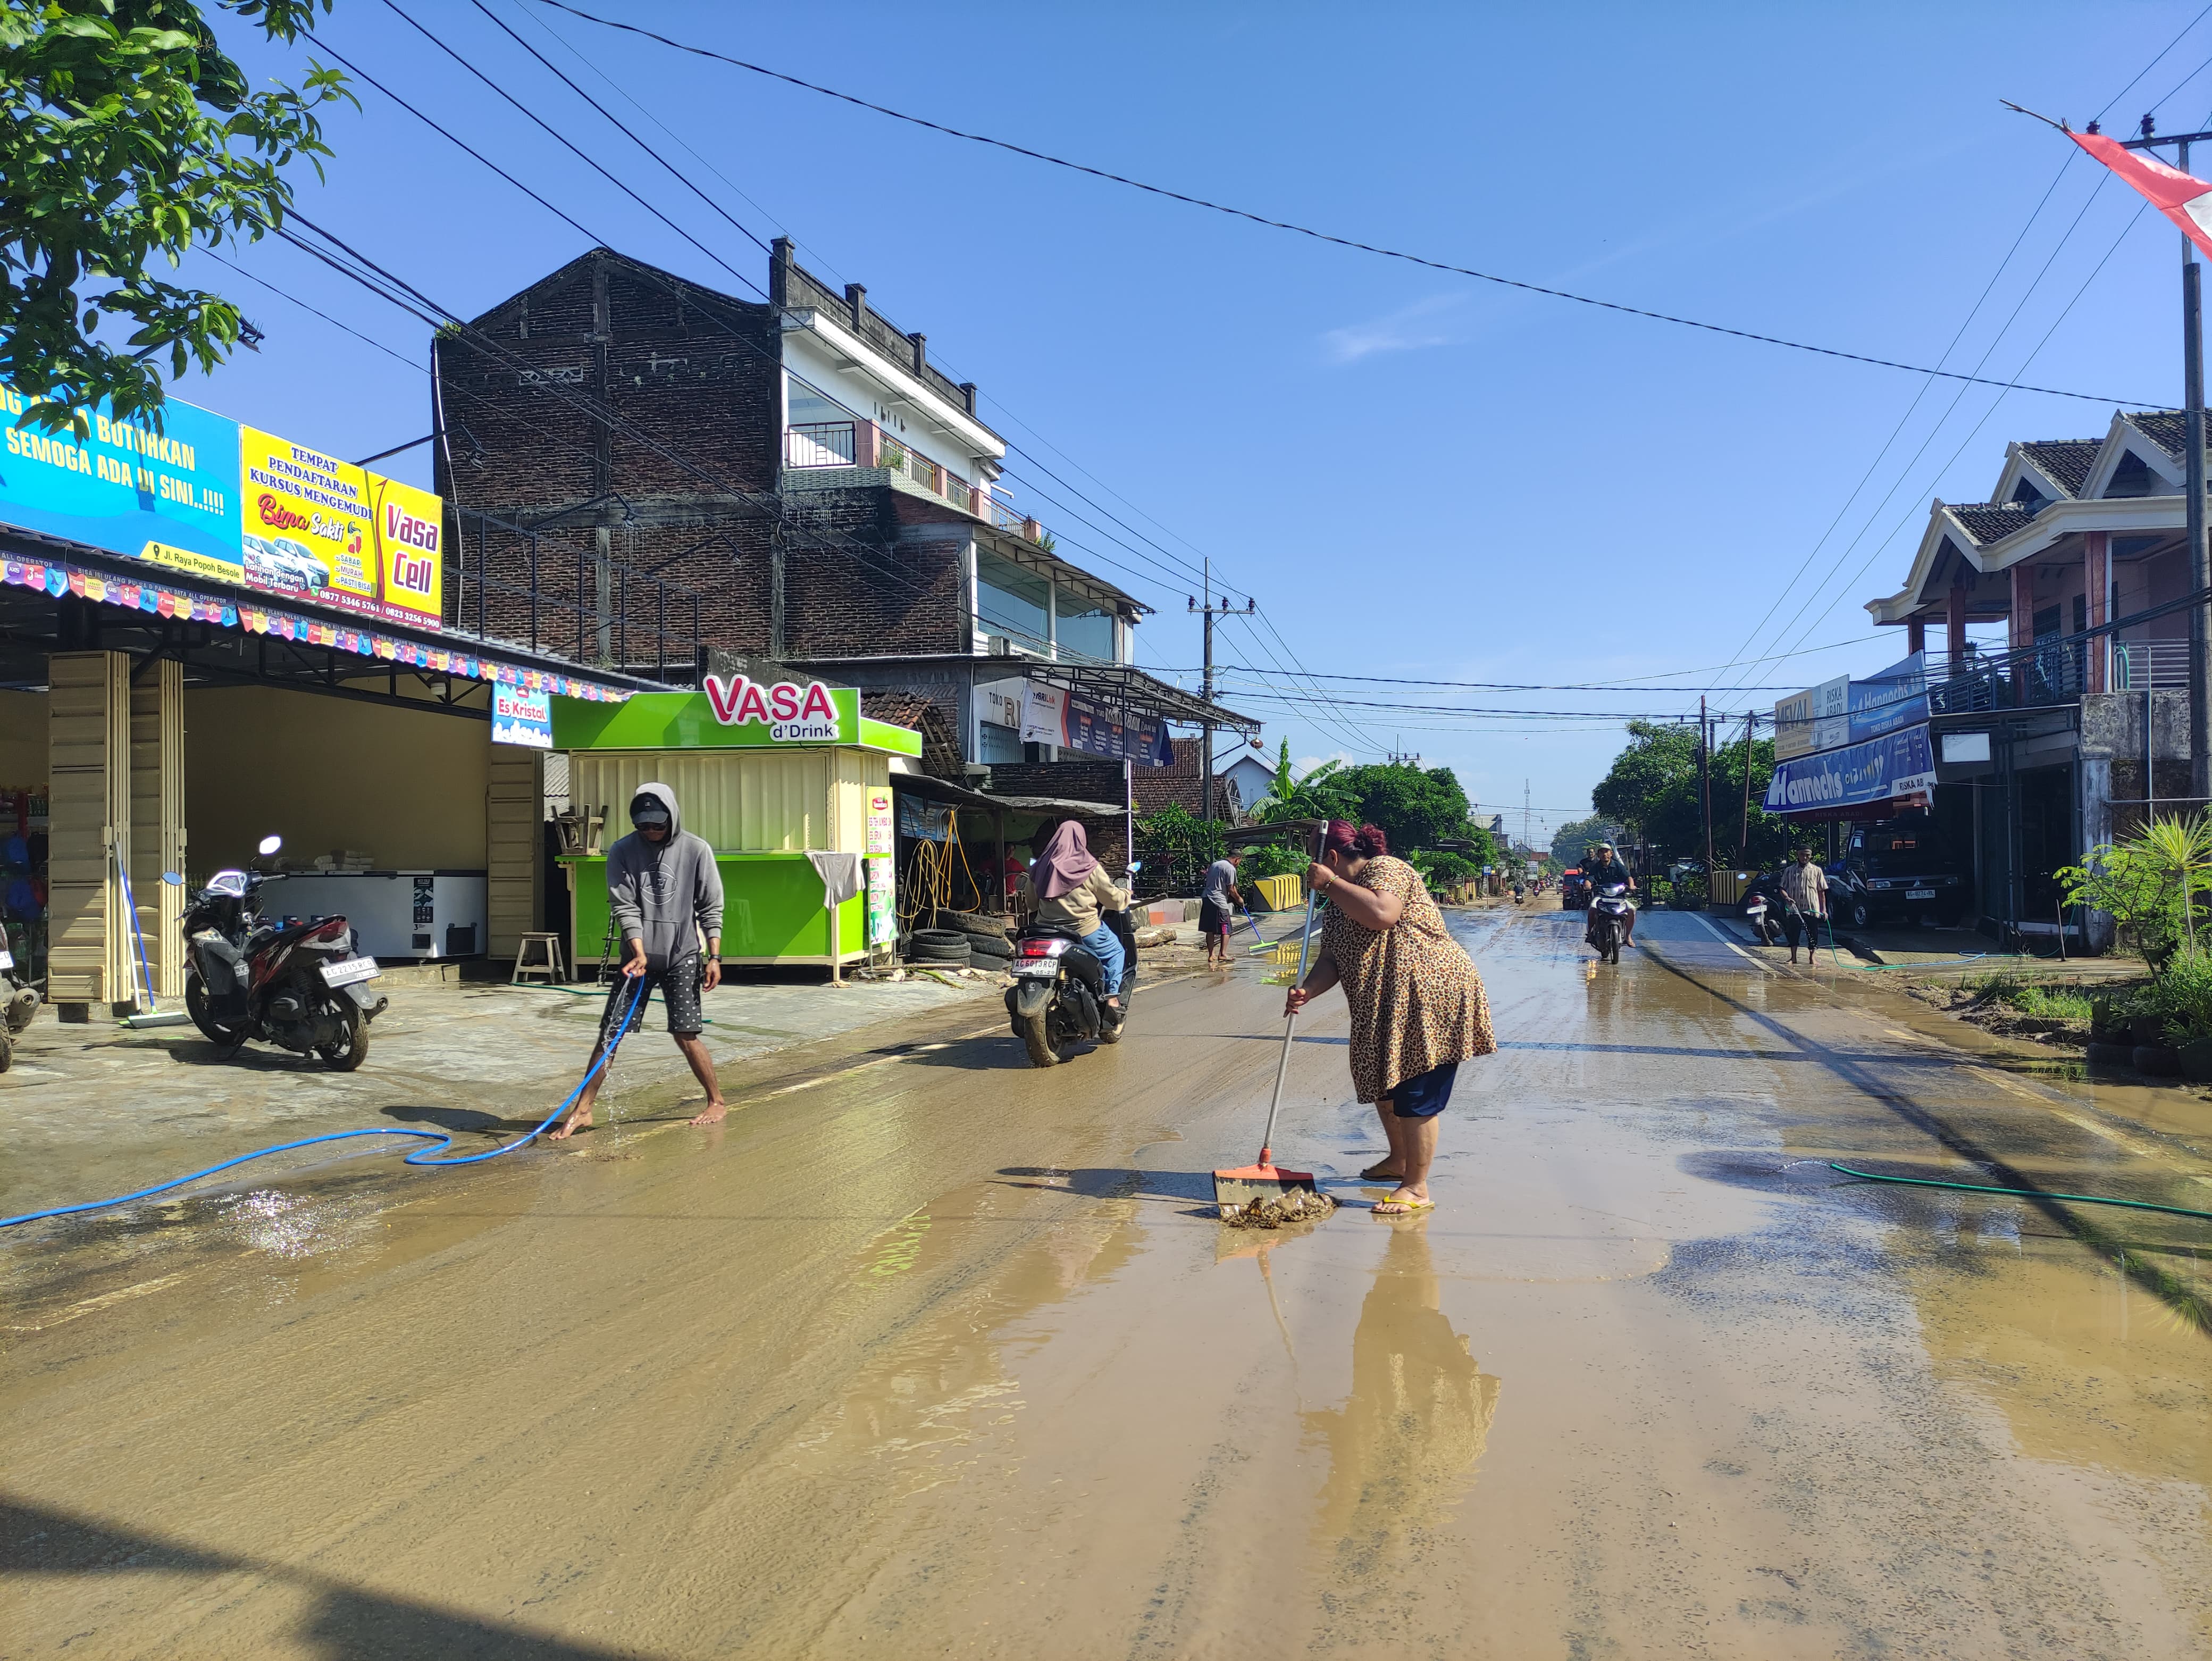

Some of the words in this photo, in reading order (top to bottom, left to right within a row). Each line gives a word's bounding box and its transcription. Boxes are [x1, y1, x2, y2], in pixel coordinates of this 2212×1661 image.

[97, 414, 195, 472] BUTUHKAN
[6, 427, 92, 476] SEMOGA
[98, 454, 133, 488] ADA
[137, 466, 155, 495] DI
[291, 447, 338, 474] TEMPAT
[269, 456, 358, 498] PENDAFTARAN
[250, 468, 301, 496] KURSUS
[304, 487, 373, 521] MENGEMUDI
[258, 494, 310, 530] Bima
[311, 512, 345, 542] Sakti
[388, 504, 438, 552] Vasa
[16, 556, 53, 568] OPERATOR
[164, 550, 173, 561] Jl.
[174, 553, 192, 566] Raya
[194, 558, 215, 572] Popoh
[217, 564, 240, 578] Besole
[246, 560, 274, 576] Latihan
[276, 569, 304, 583] dengan
[341, 555, 362, 567] SABAR
[341, 566, 363, 578] MURAH
[394, 553, 432, 594] Cell
[78, 567, 93, 577] BISA
[104, 574, 126, 585] ULANG
[199, 595, 227, 604] OPERATOR
[246, 572, 268, 585] Mobil
[269, 578, 299, 592] Terbaru
[341, 577, 357, 587] PASTI
[358, 581, 371, 591] BISA
[320, 590, 339, 602] 0877
[341, 596, 361, 607] 5346
[362, 602, 380, 613] 5761
[386, 607, 404, 619] 0823
[405, 613, 422, 624] 3256
[423, 618, 440, 629] 5900
[706, 677, 833, 722] VASA
[989, 692, 1002, 707] TOKO
[1826, 686, 1842, 704] RISKA
[498, 698, 510, 714] Es
[512, 700, 546, 721] Kristal
[773, 723, 834, 739] d'Drink
[1870, 723, 1881, 733] TOKO
[1893, 715, 1904, 726] ABADI
[1767, 761, 1842, 806] Hannochs
